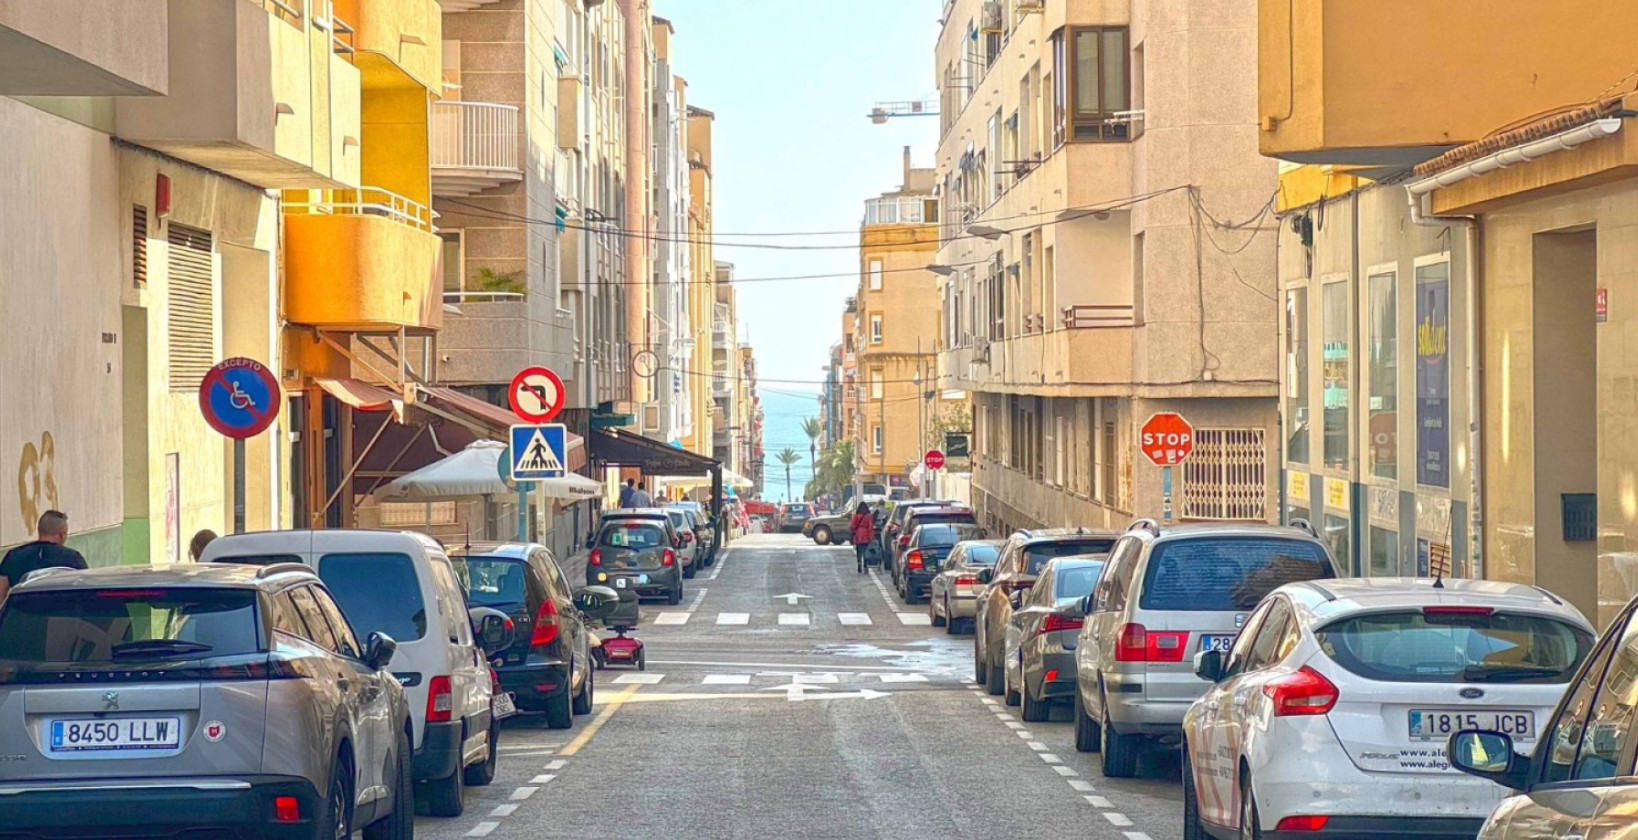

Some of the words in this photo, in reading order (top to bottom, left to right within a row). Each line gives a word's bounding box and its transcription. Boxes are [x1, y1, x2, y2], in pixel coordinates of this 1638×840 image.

[217, 359, 262, 371] EXCEPTO
[1143, 432, 1190, 446] STOP
[1213, 637, 1231, 651] 28
[58, 671, 165, 679] PEUGEOT
[1427, 714, 1479, 733] 1815
[1489, 714, 1528, 734] JCB
[68, 723, 119, 743] 8450
[129, 721, 169, 742] LLW
[1400, 748, 1447, 757] www.ale
[1400, 760, 1452, 771] www.aleg
